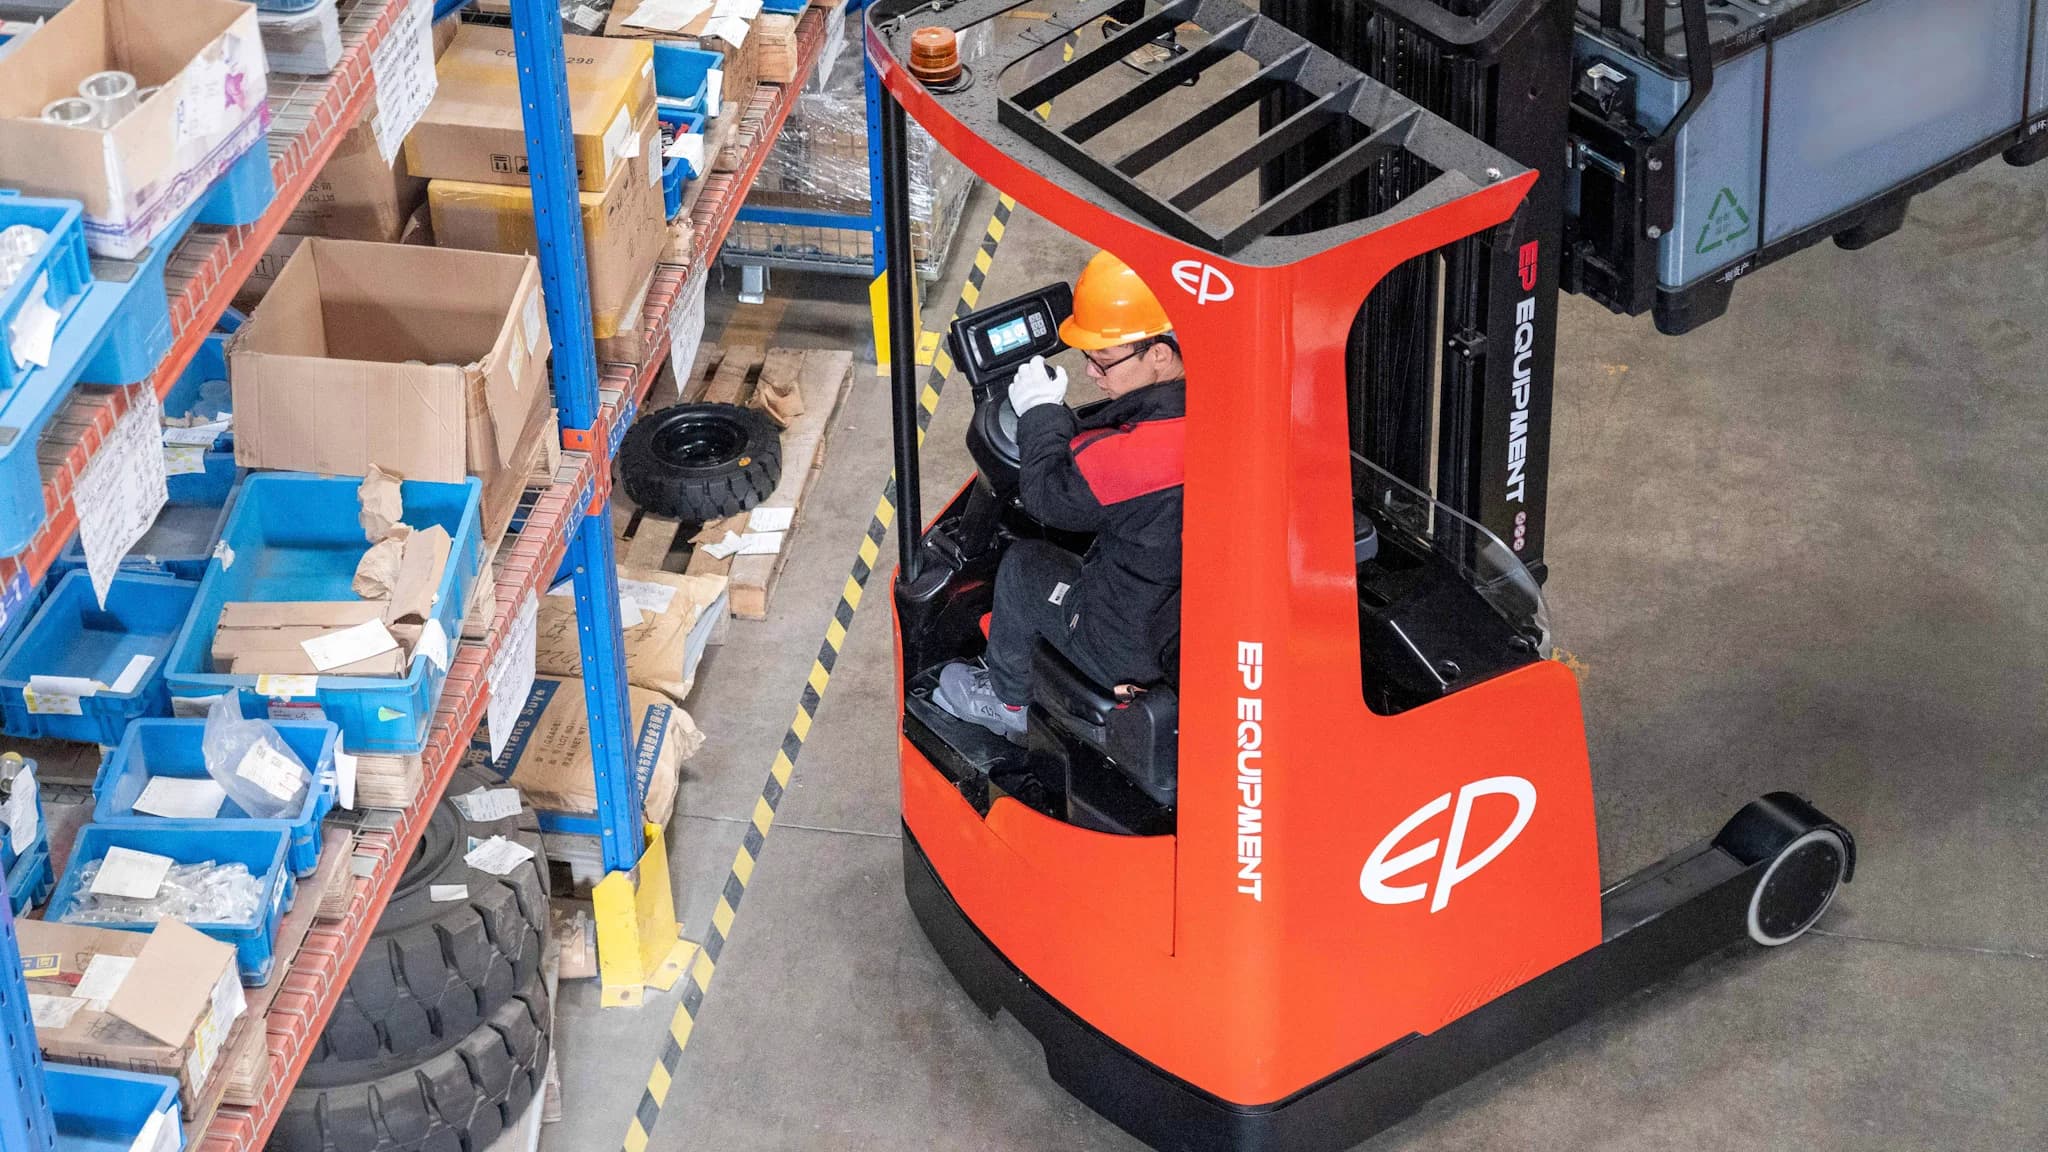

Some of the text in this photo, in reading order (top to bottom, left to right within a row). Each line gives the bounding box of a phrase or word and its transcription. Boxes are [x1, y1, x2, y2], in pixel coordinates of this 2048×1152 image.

[1171, 260, 1234, 304] EP
[1518, 239, 1539, 292] EP
[1506, 296, 1536, 504] EQUIPMENT
[1237, 641, 1263, 902] EP EQUIPMENT
[1359, 775, 1537, 913] EP
